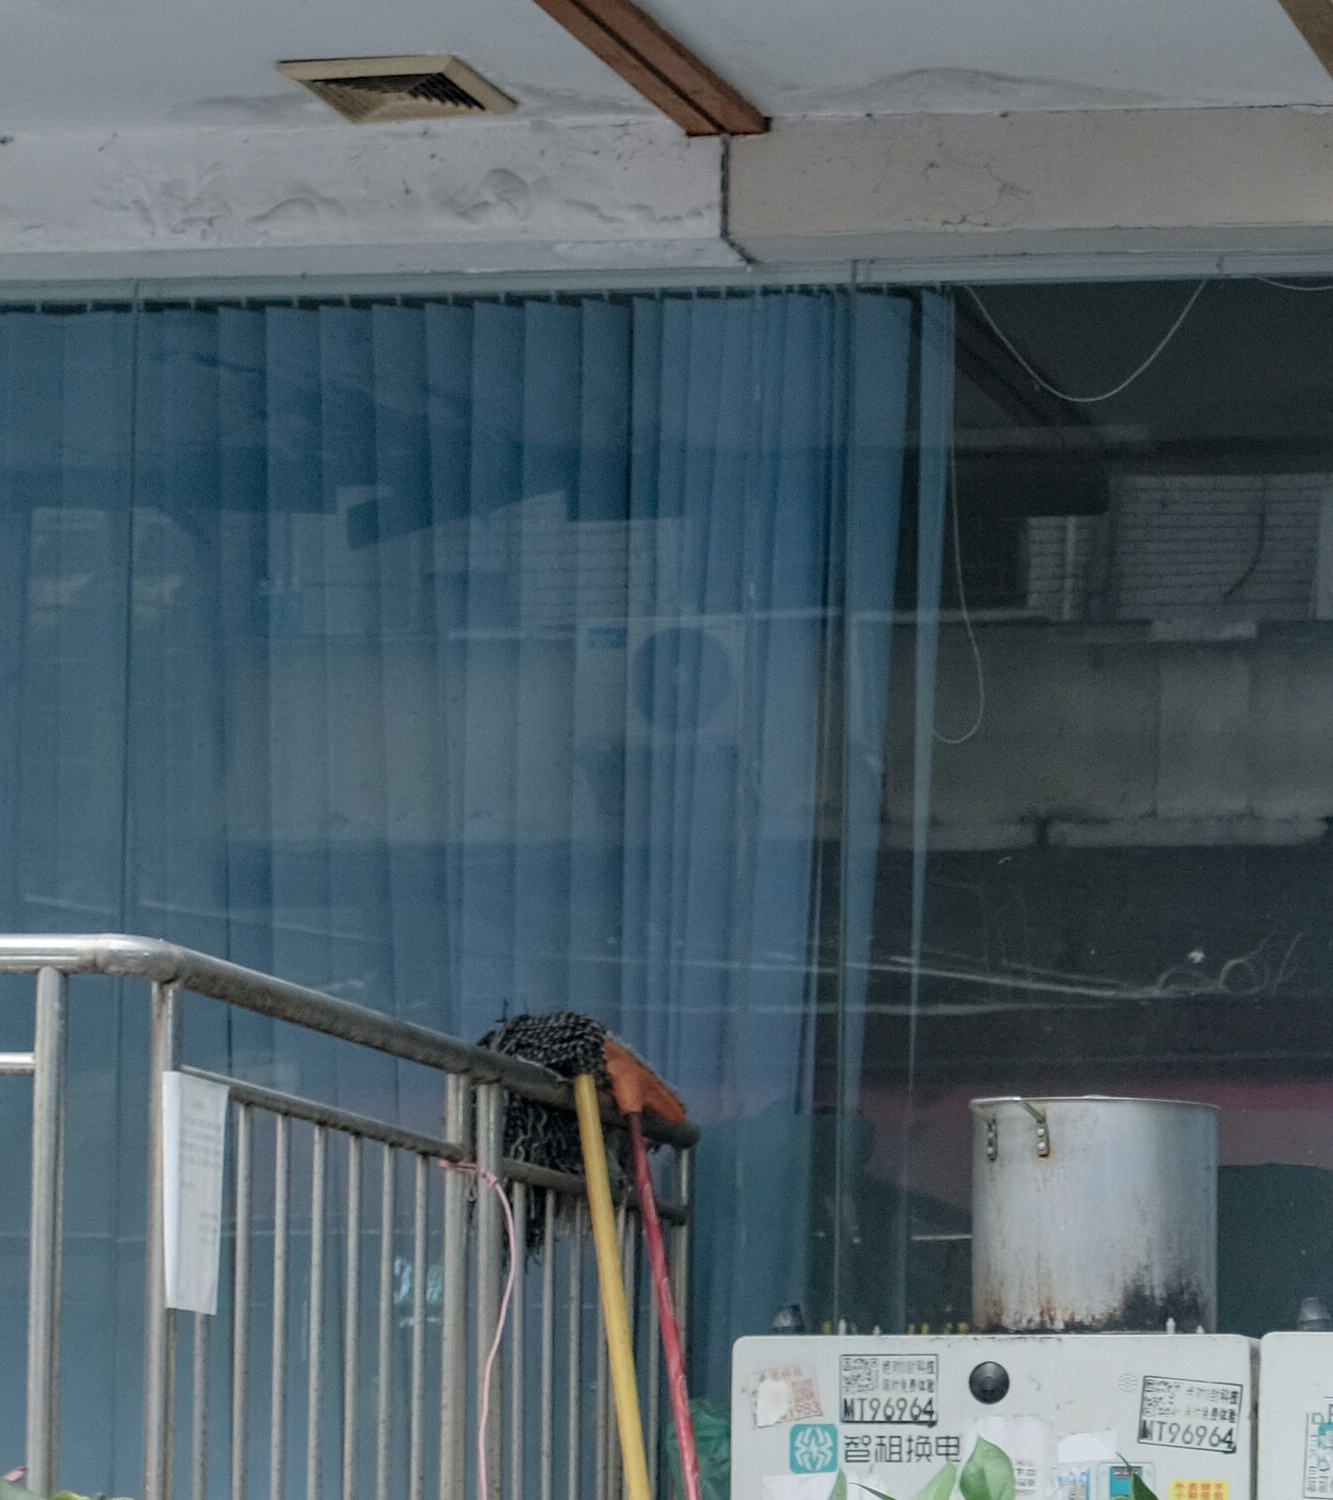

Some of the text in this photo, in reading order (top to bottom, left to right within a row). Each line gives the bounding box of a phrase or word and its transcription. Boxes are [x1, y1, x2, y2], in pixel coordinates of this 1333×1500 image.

[843, 1397, 935, 1420] MT96964
[843, 1434, 962, 1463] 智租换电
